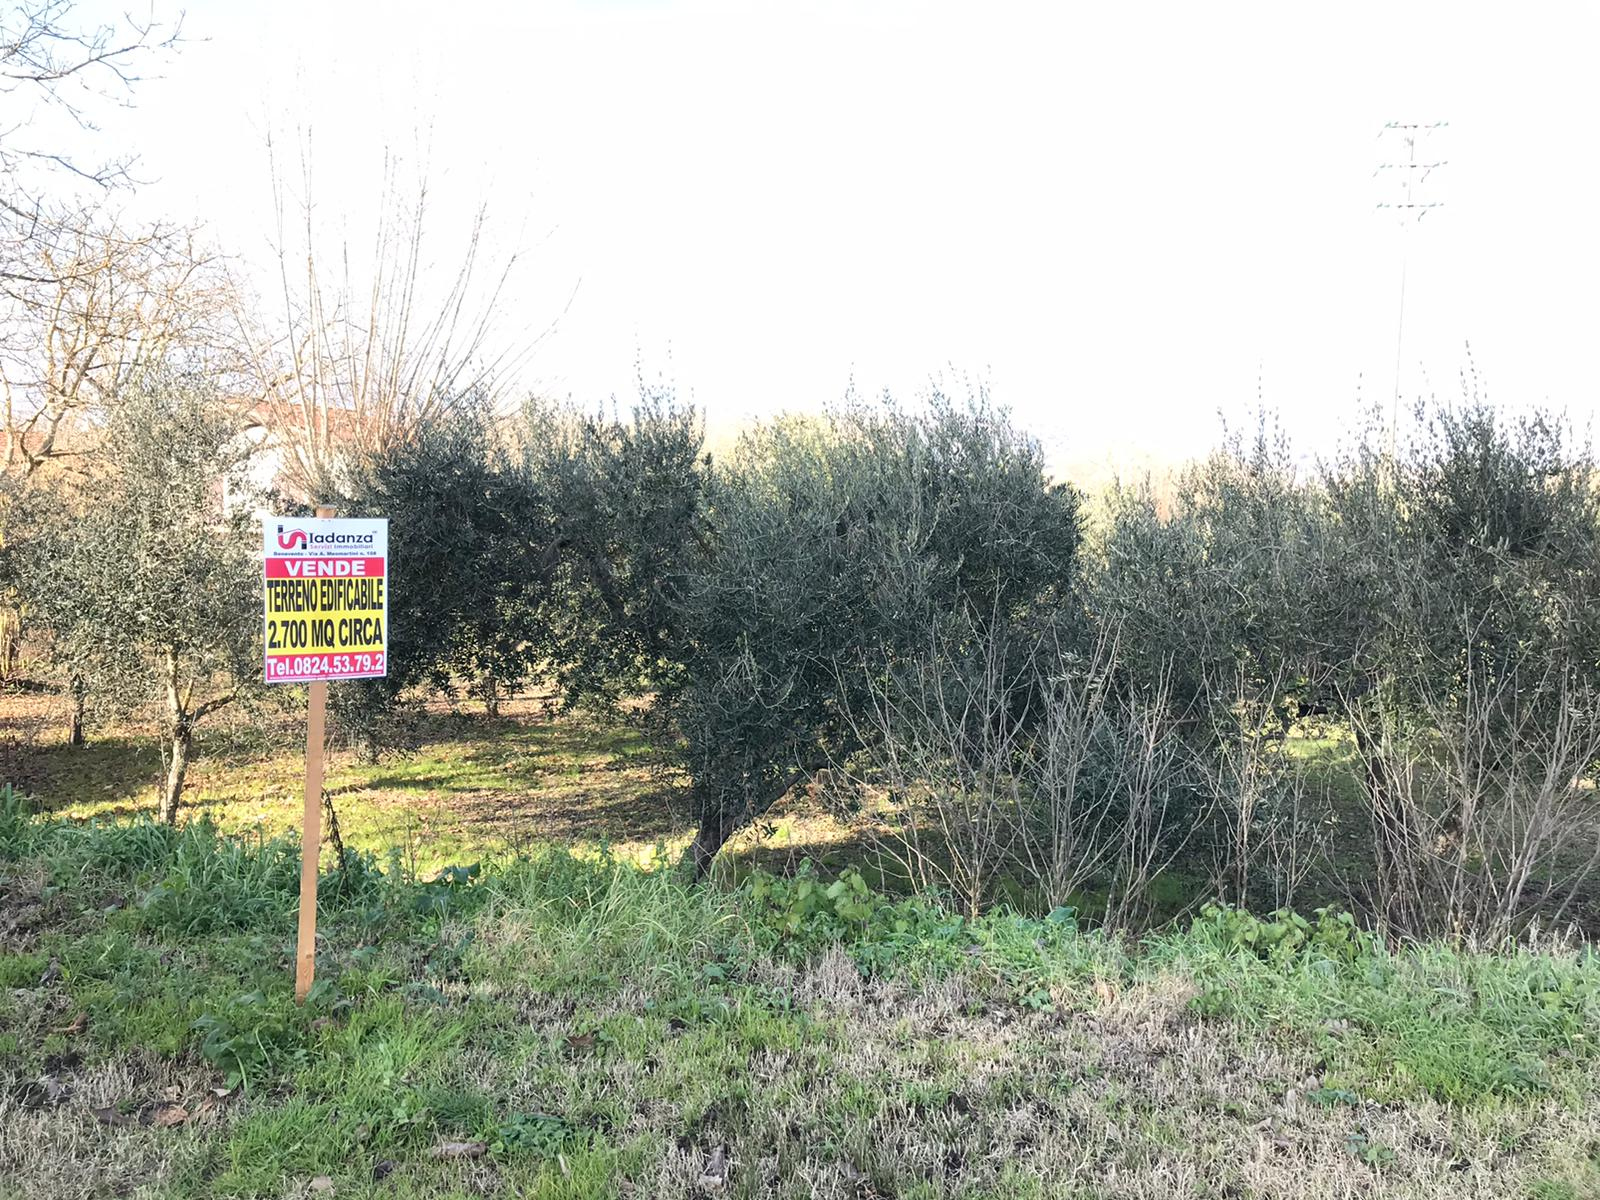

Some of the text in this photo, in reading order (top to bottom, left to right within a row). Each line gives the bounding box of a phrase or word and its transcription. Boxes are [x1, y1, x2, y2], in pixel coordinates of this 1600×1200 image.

[284, 560, 366, 576] VENDE
[267, 578, 384, 612] TERRENO EDIFICABILE
[268, 617, 383, 649] 2.700 MQ CIRCA
[268, 653, 384, 676] Tel.0824.53.79.2
